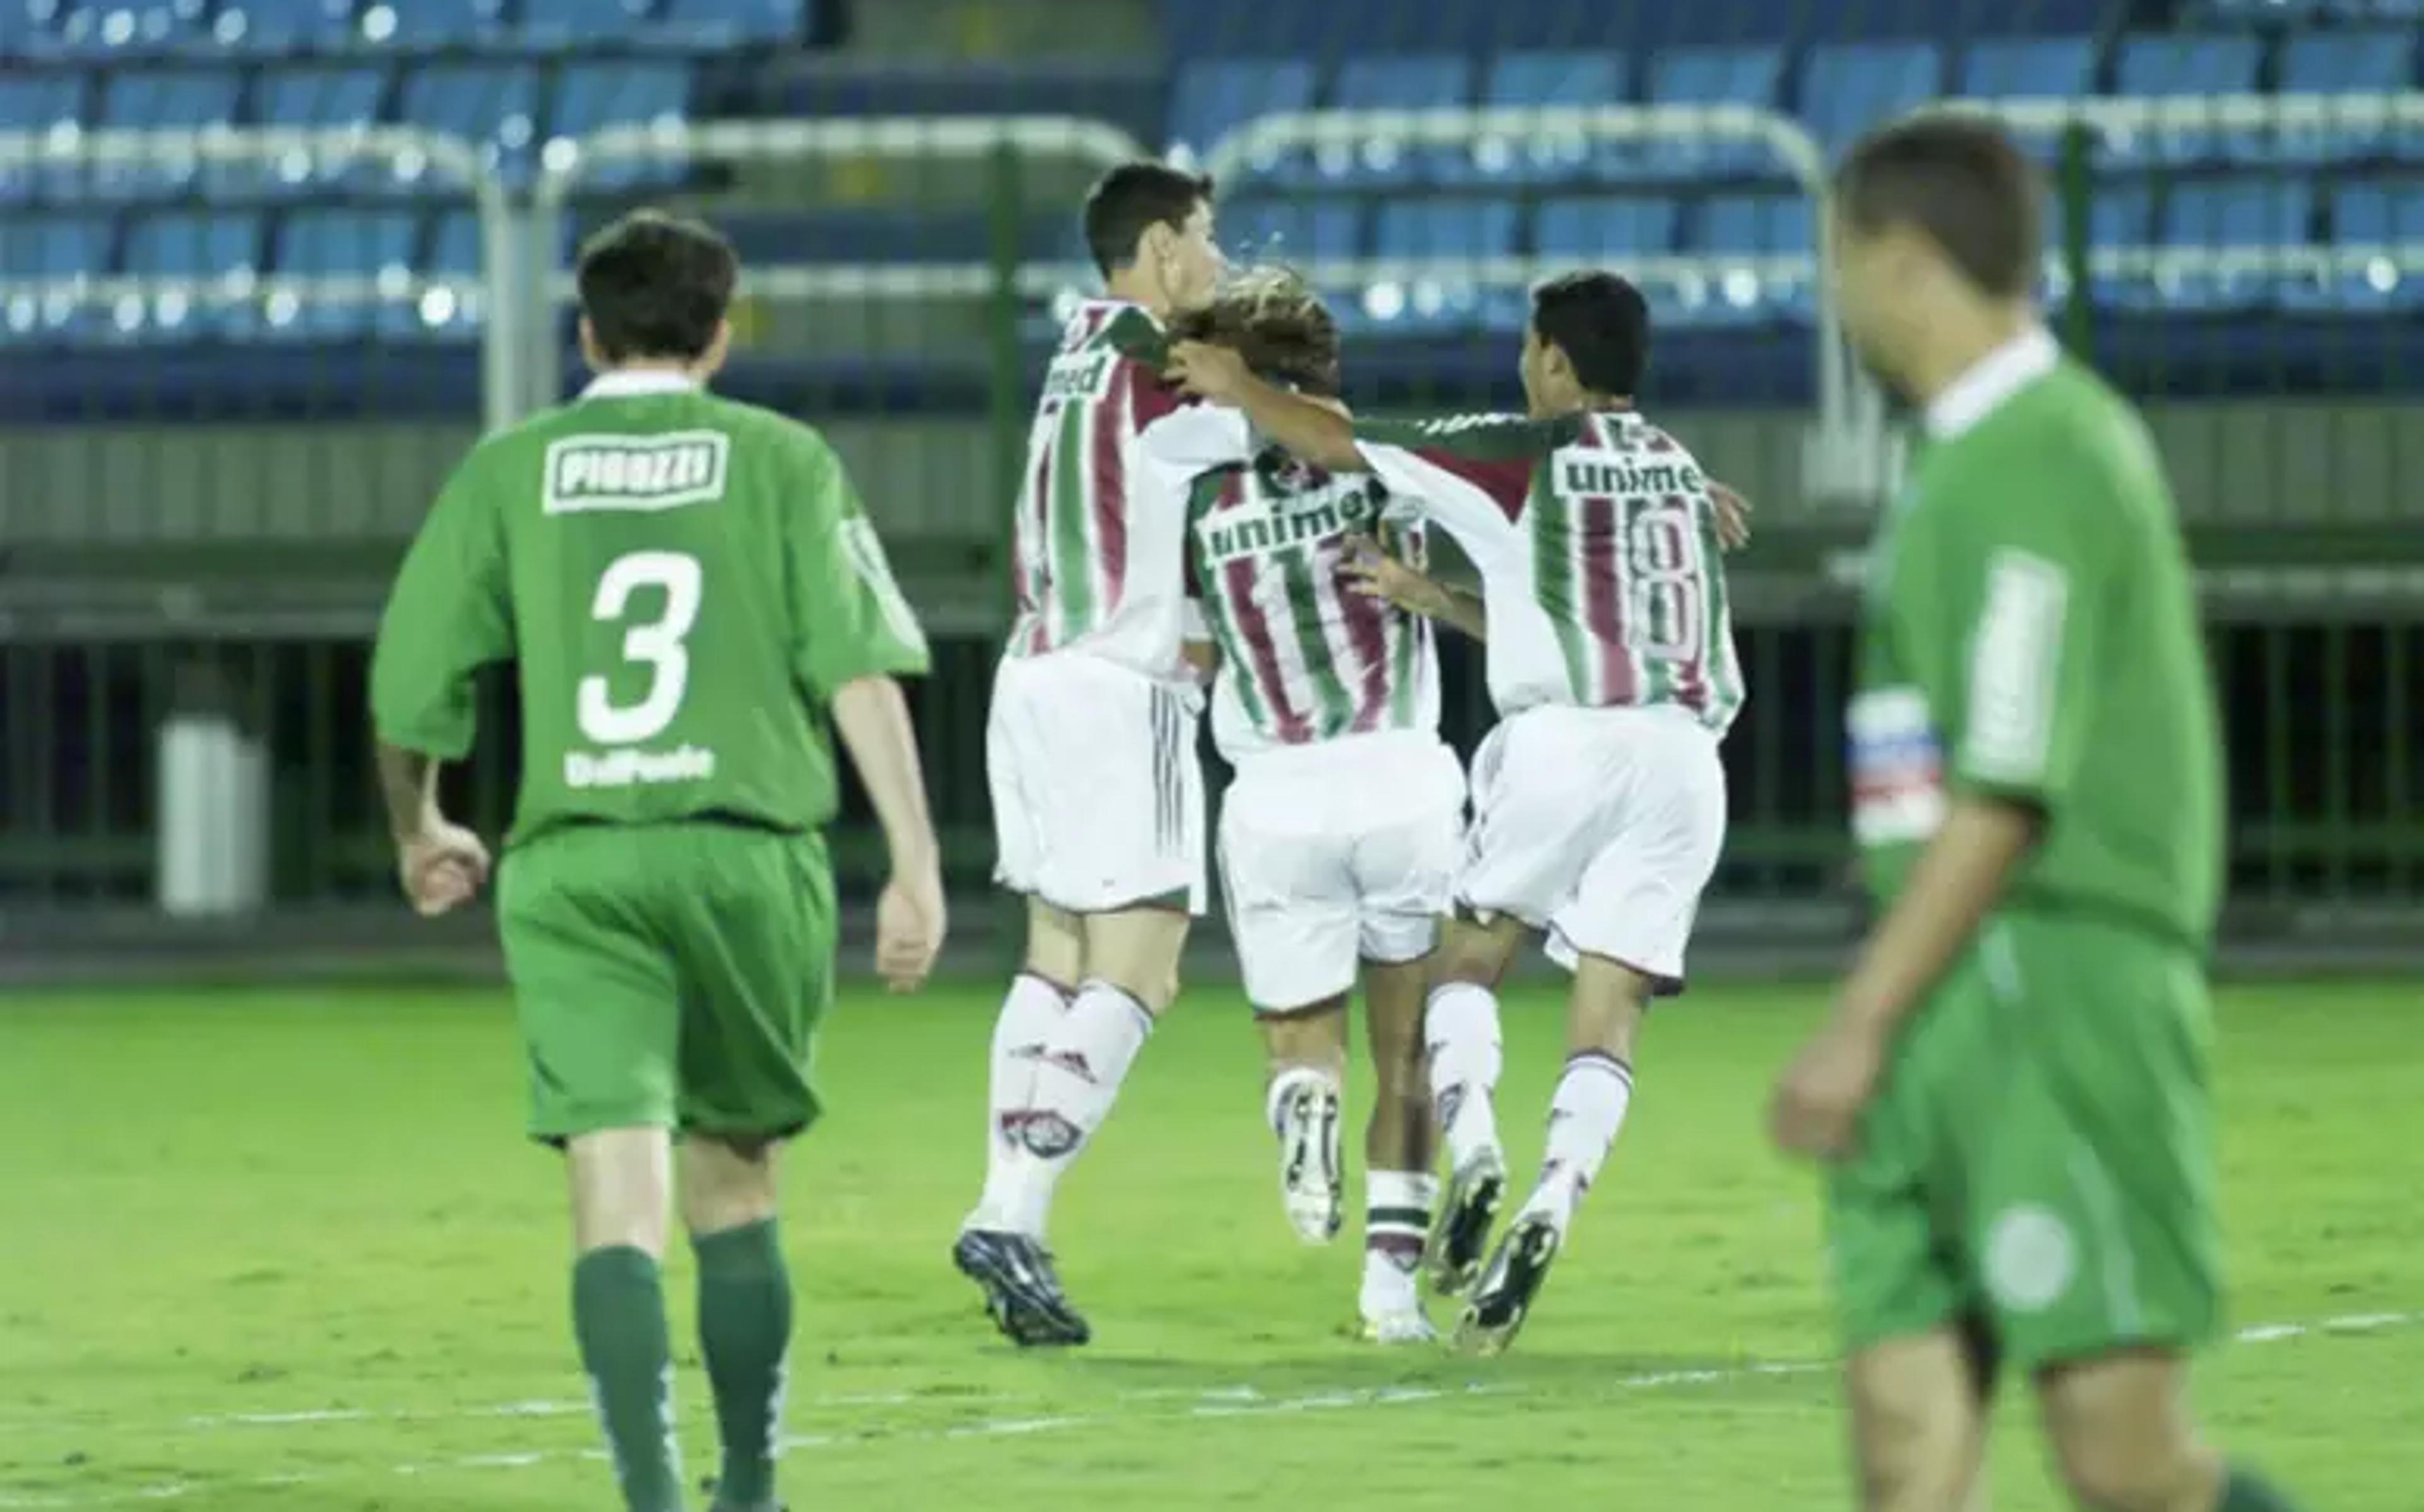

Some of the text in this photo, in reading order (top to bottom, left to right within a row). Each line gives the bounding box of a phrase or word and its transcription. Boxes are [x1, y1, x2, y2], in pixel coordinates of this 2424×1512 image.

[1209, 488, 1371, 557] unime
[1565, 456, 1702, 495] unime
[1630, 506, 1701, 661] 8
[575, 549, 703, 744] 3
